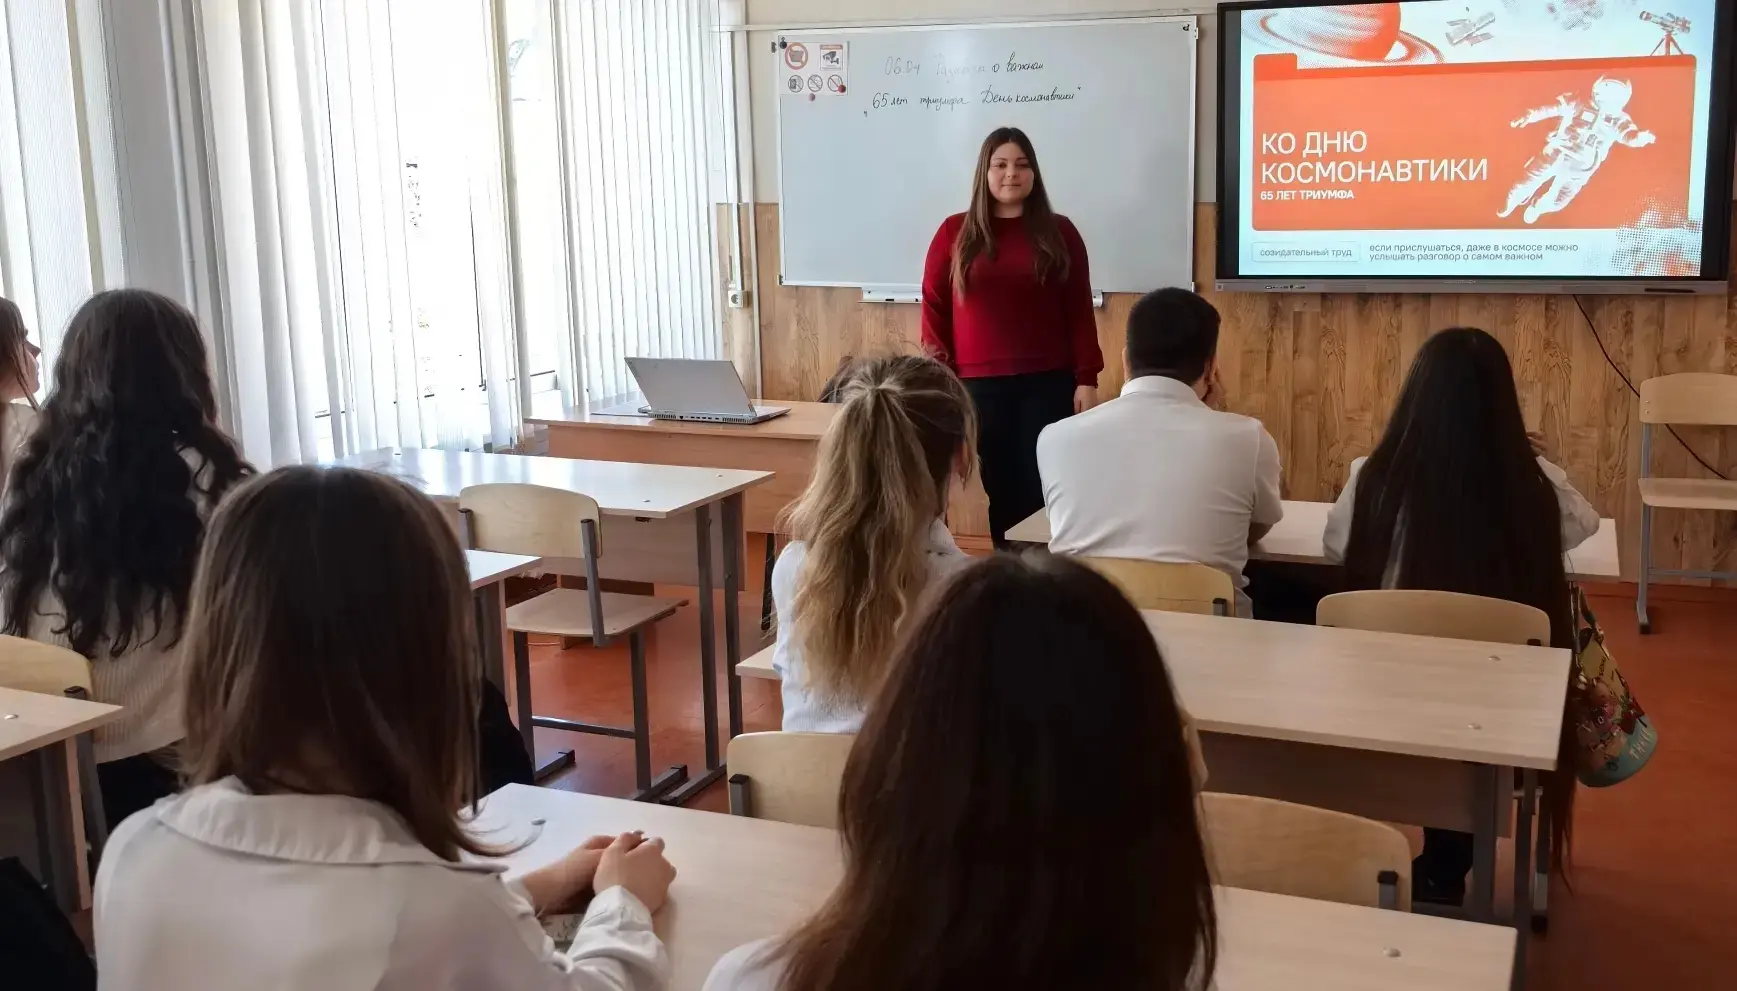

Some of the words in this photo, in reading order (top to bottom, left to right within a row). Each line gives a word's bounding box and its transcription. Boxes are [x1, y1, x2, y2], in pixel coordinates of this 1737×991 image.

[991, 63, 1000, 73] о
[980, 85, 1013, 104] День
[1262, 132, 1296, 155] КО
[1302, 130, 1368, 158] ДНЮ
[1261, 158, 1488, 184] КОСМОНАВТИКИ
[1260, 191, 1274, 200] 65
[1275, 190, 1297, 200] ЛЕТ
[1299, 189, 1355, 200] ТРИУМФА
[1260, 248, 1329, 257] созидательный
[1332, 249, 1352, 258] труд
[1394, 244, 1464, 253] прислушаться,
[1466, 244, 1491, 252] даже
[1369, 253, 1414, 262] услышать
[1417, 253, 1461, 262] разговор
